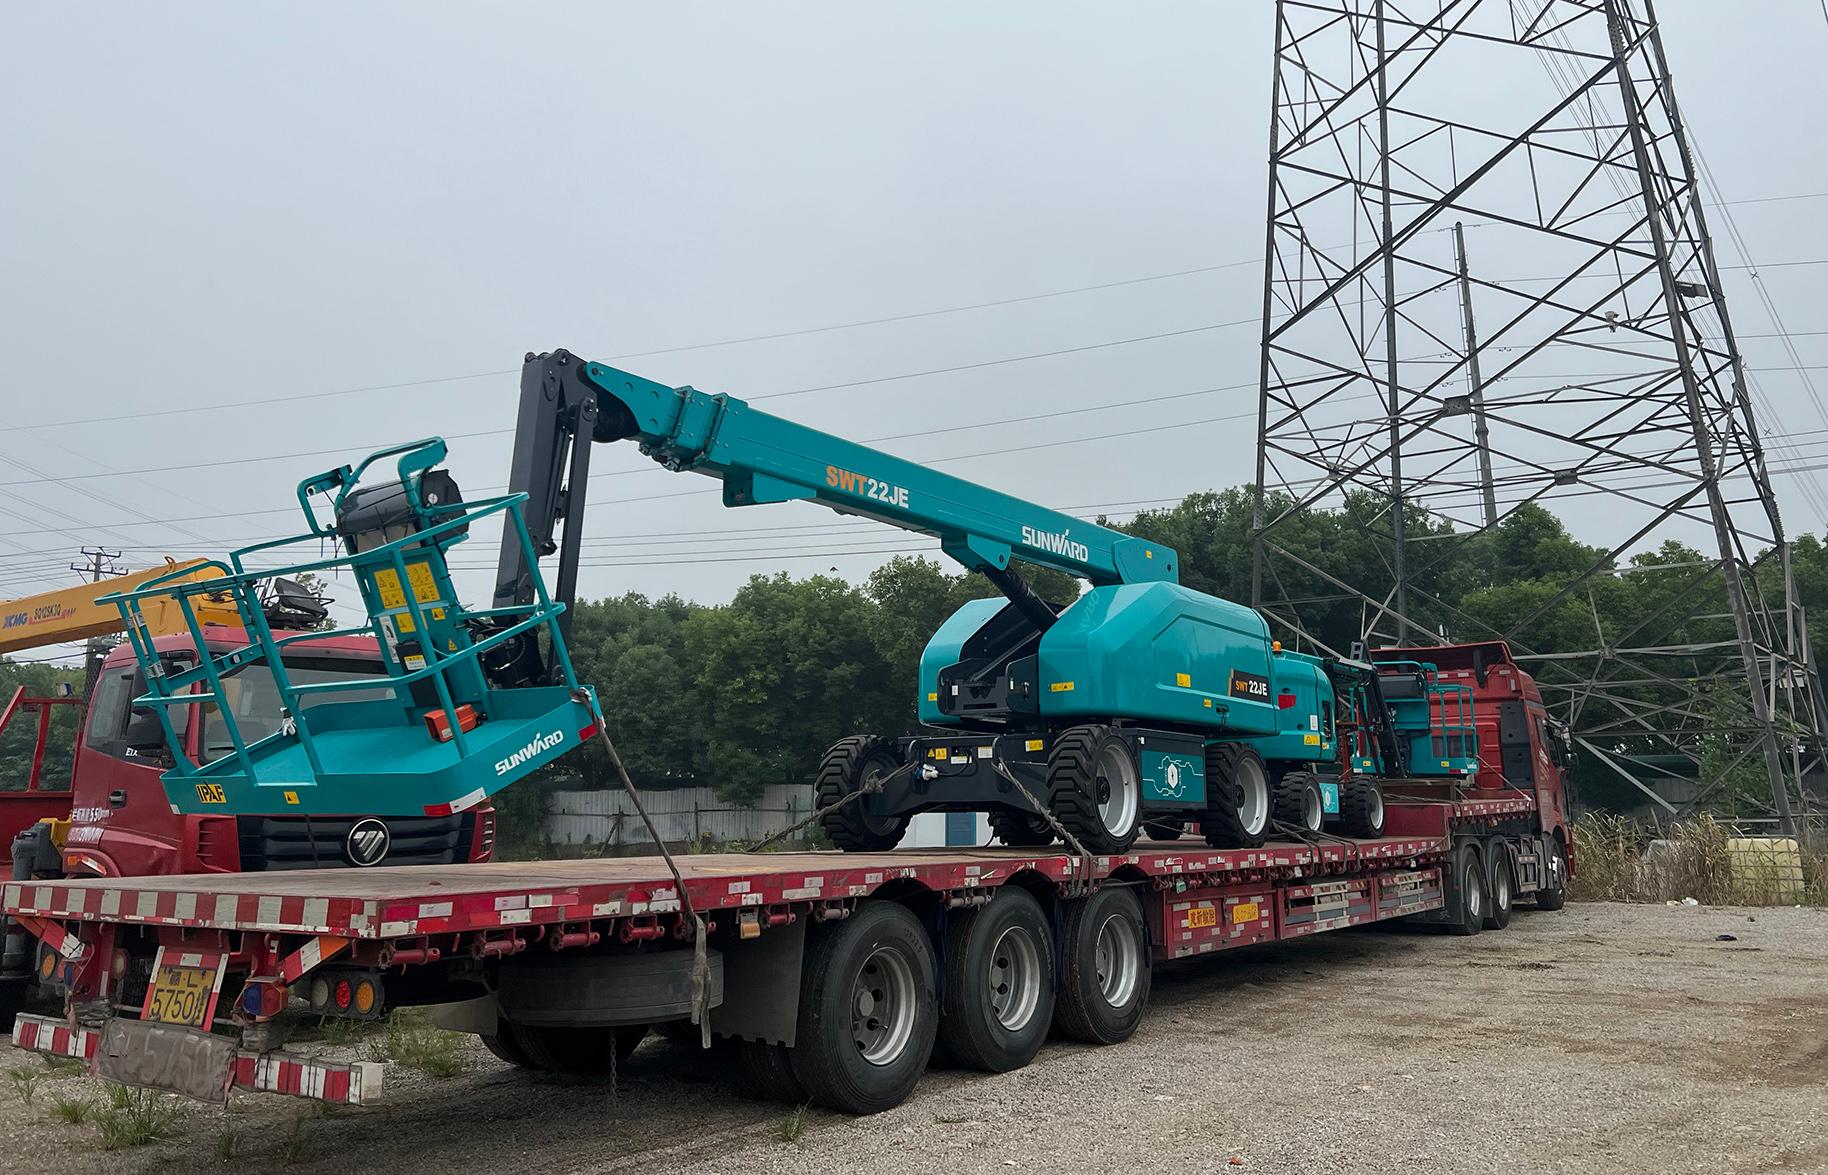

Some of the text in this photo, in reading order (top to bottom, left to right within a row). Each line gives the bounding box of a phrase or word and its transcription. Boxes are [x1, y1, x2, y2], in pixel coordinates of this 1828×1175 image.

[826, 465, 909, 508] SWT22JE
[1021, 525, 1089, 563] SUNWARD
[2, 612, 28, 629] XCMG
[494, 730, 564, 776] SUNWARD
[197, 780, 223, 802] IPAF
